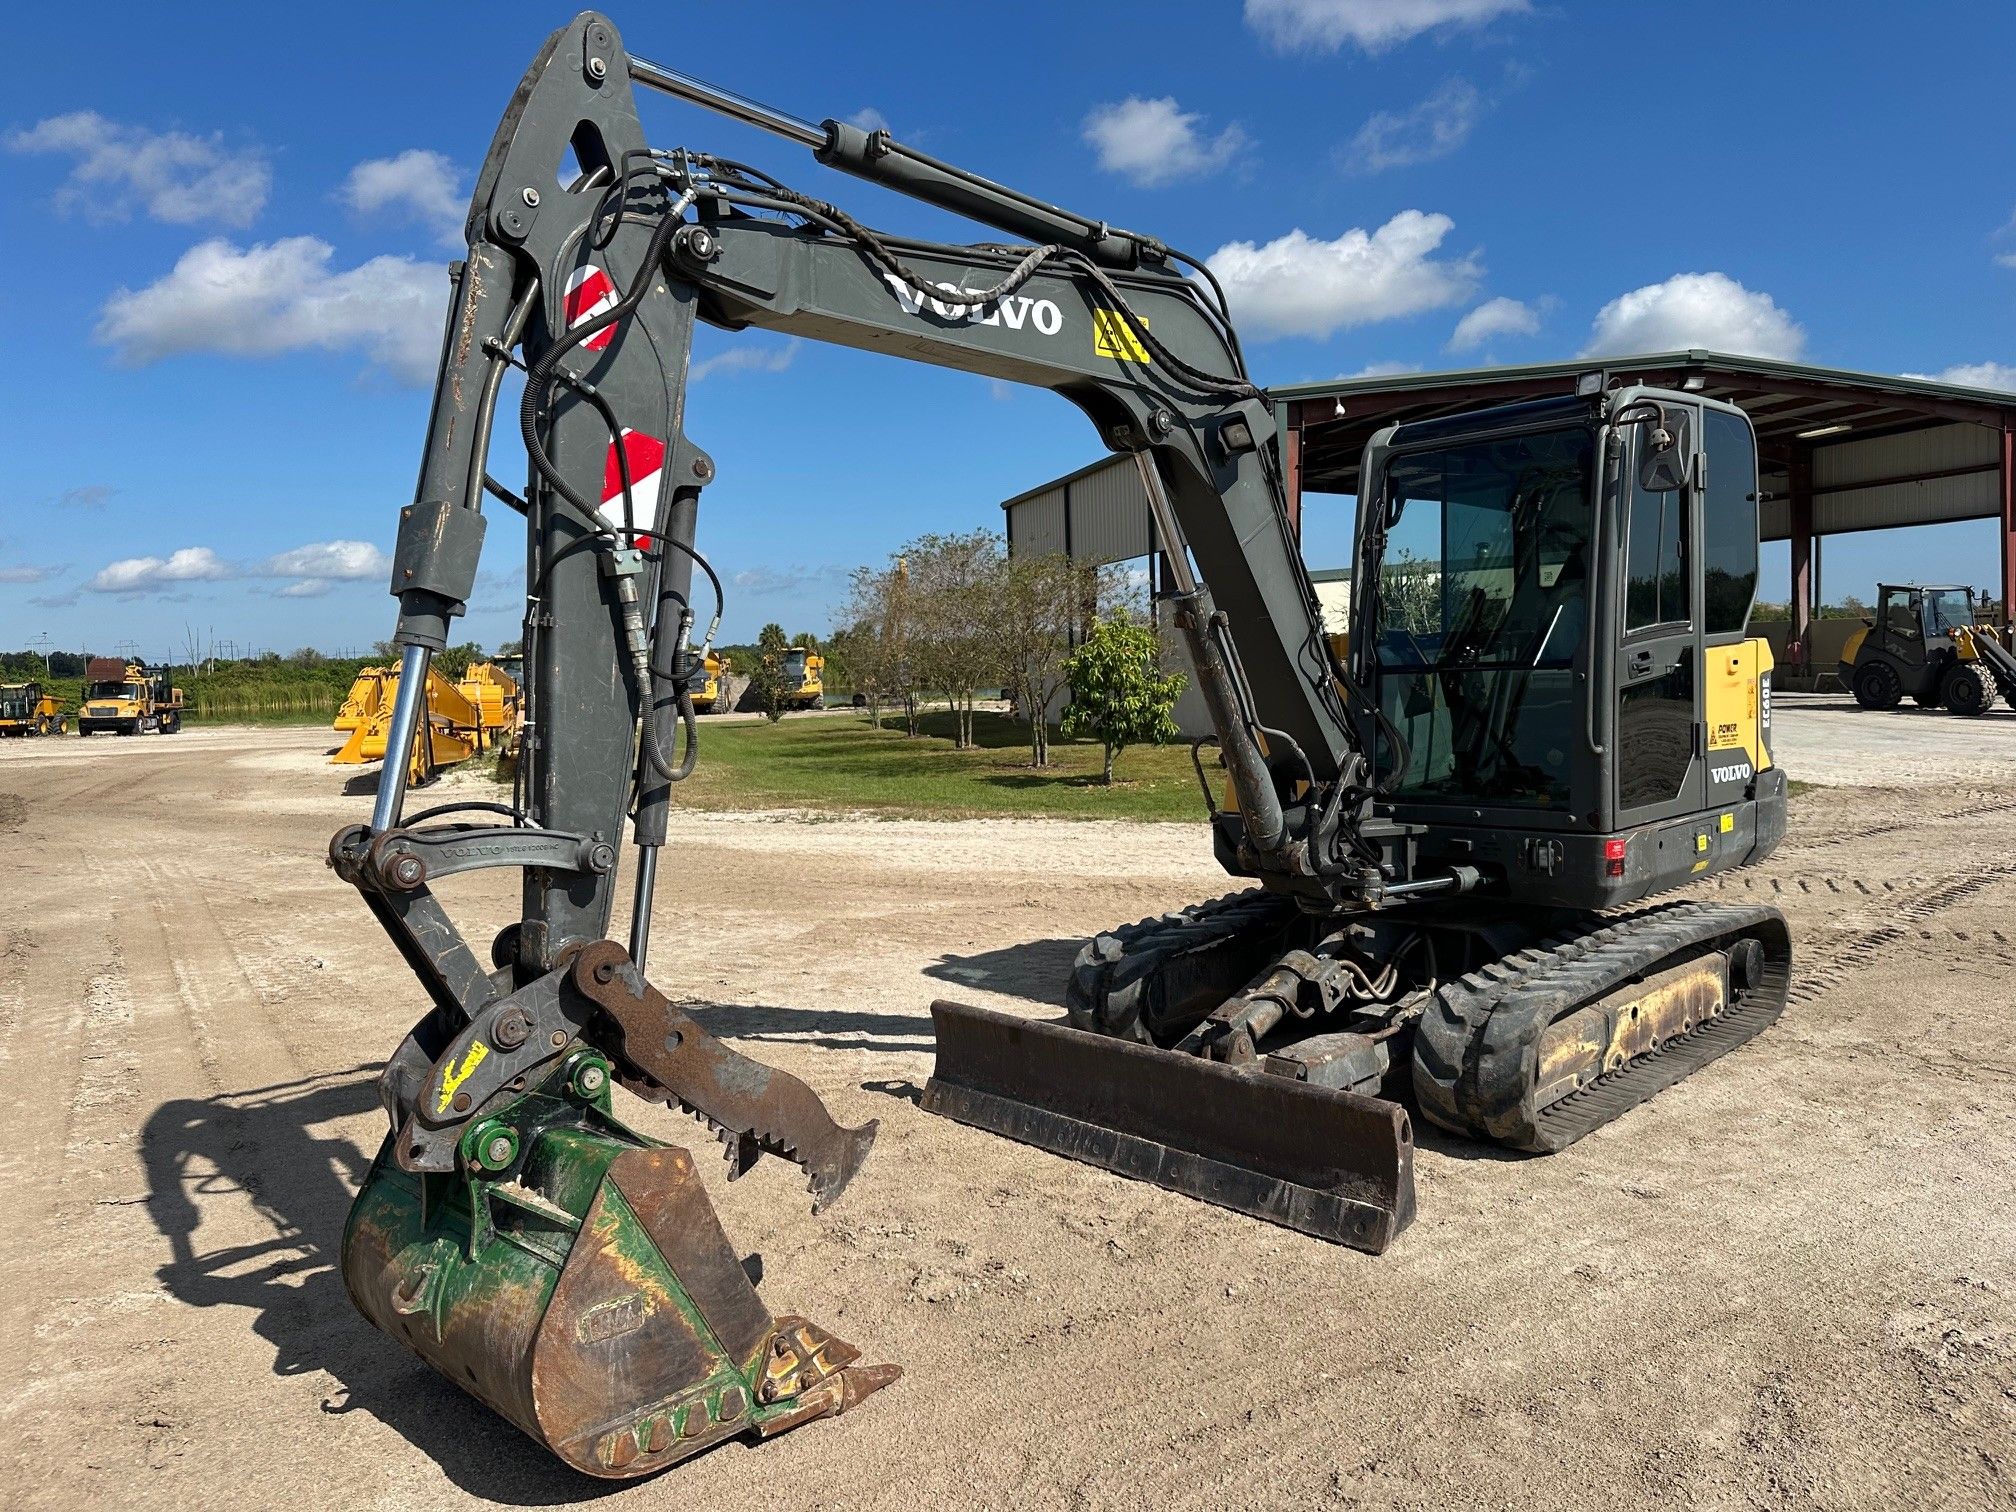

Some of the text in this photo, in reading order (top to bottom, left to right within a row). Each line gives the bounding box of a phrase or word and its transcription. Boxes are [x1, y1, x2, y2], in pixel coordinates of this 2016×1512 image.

[884, 273, 1063, 336] VOLVO
[1762, 678, 1770, 728] EC60E
[1717, 723, 1738, 734] POWER
[1711, 763, 1750, 784] VOLVO
[440, 846, 503, 859] VOLVO
